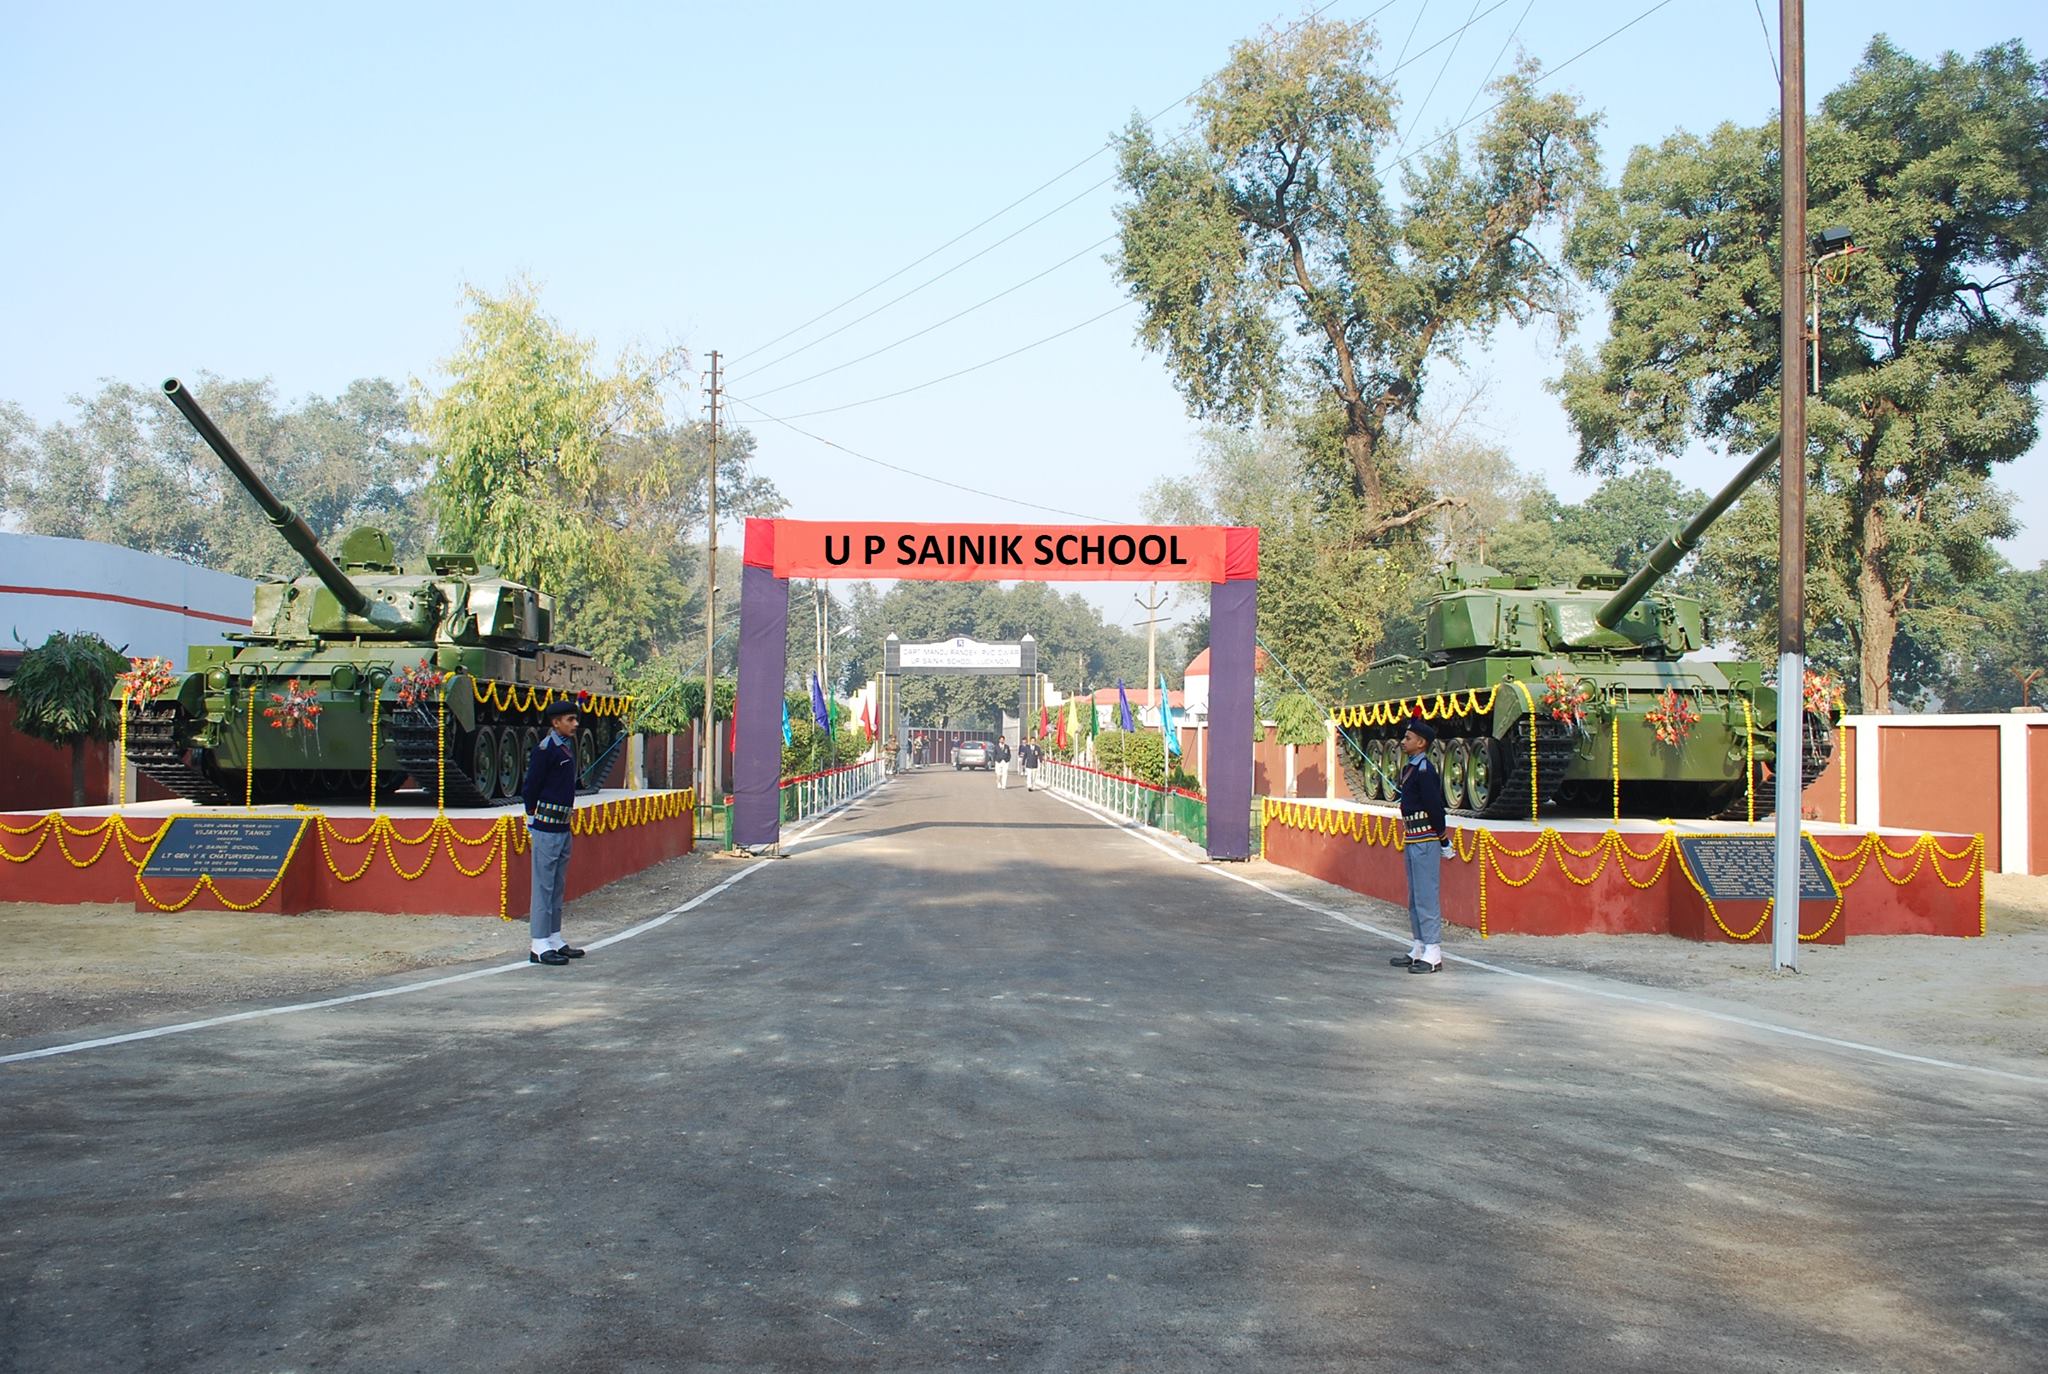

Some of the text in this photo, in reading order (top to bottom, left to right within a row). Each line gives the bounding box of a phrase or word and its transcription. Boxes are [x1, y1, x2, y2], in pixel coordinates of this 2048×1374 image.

[825, 534, 1188, 565] U P SAINIK SCHOOL
